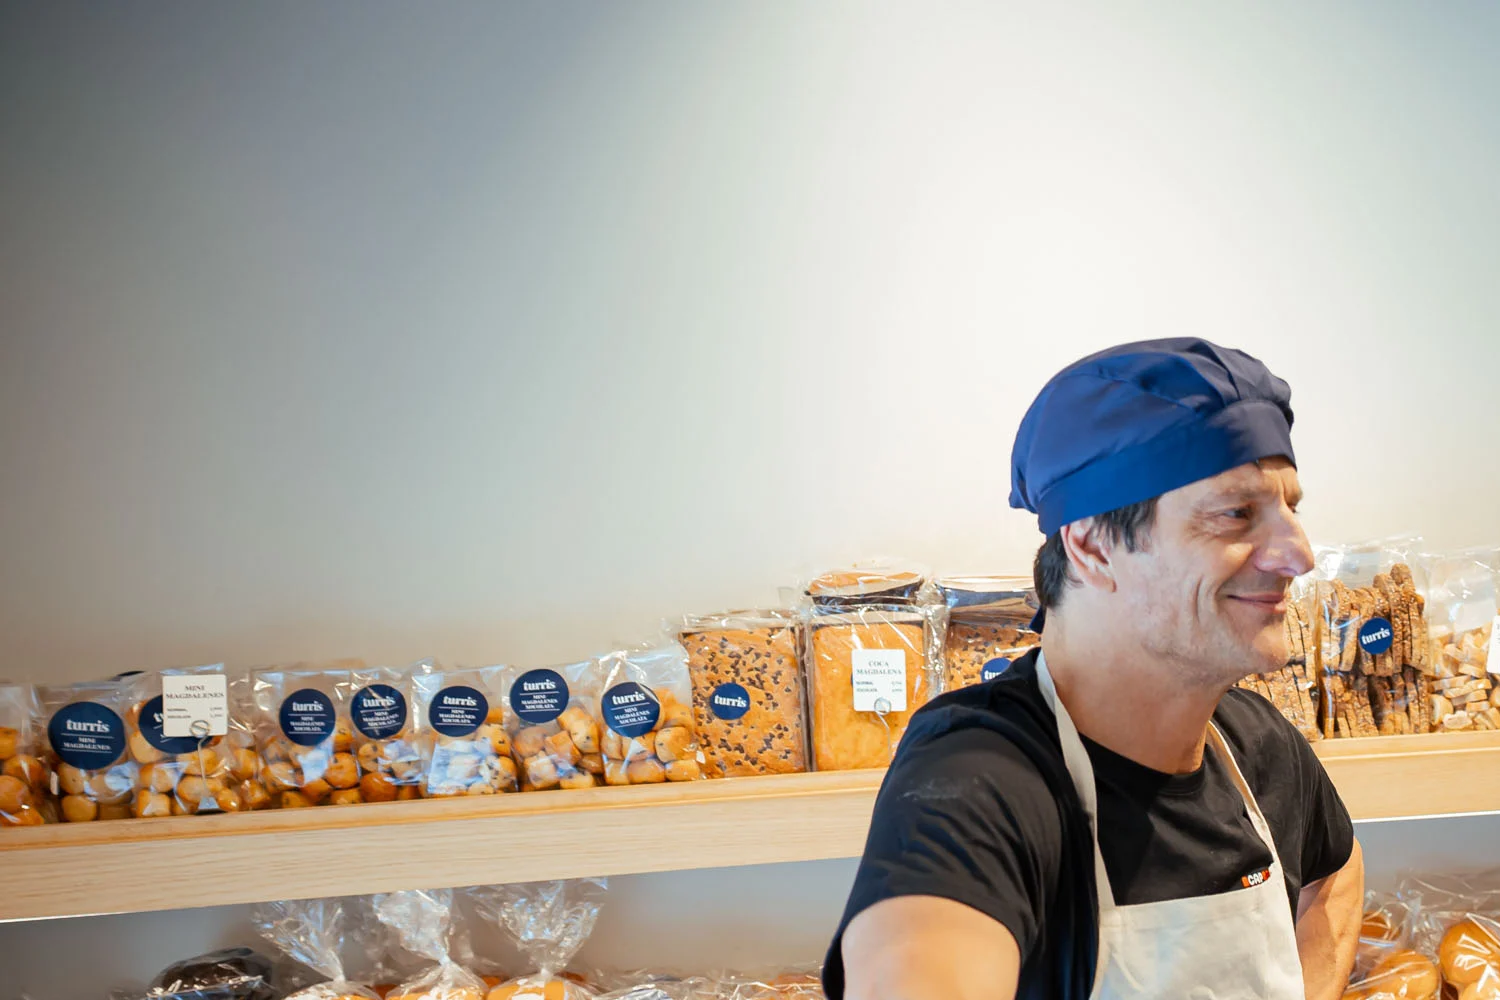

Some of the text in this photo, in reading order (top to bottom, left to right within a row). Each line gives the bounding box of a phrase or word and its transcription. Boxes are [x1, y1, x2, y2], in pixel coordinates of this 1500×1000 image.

[1361, 627, 1391, 645] turris
[523, 679, 556, 691] turris
[362, 696, 396, 708] turris
[443, 695, 477, 706] turris
[611, 691, 646, 705] turris
[714, 694, 747, 708] turris
[292, 701, 324, 712] turris
[66, 719, 111, 733] turris
[1247, 872, 1264, 886] CAP
